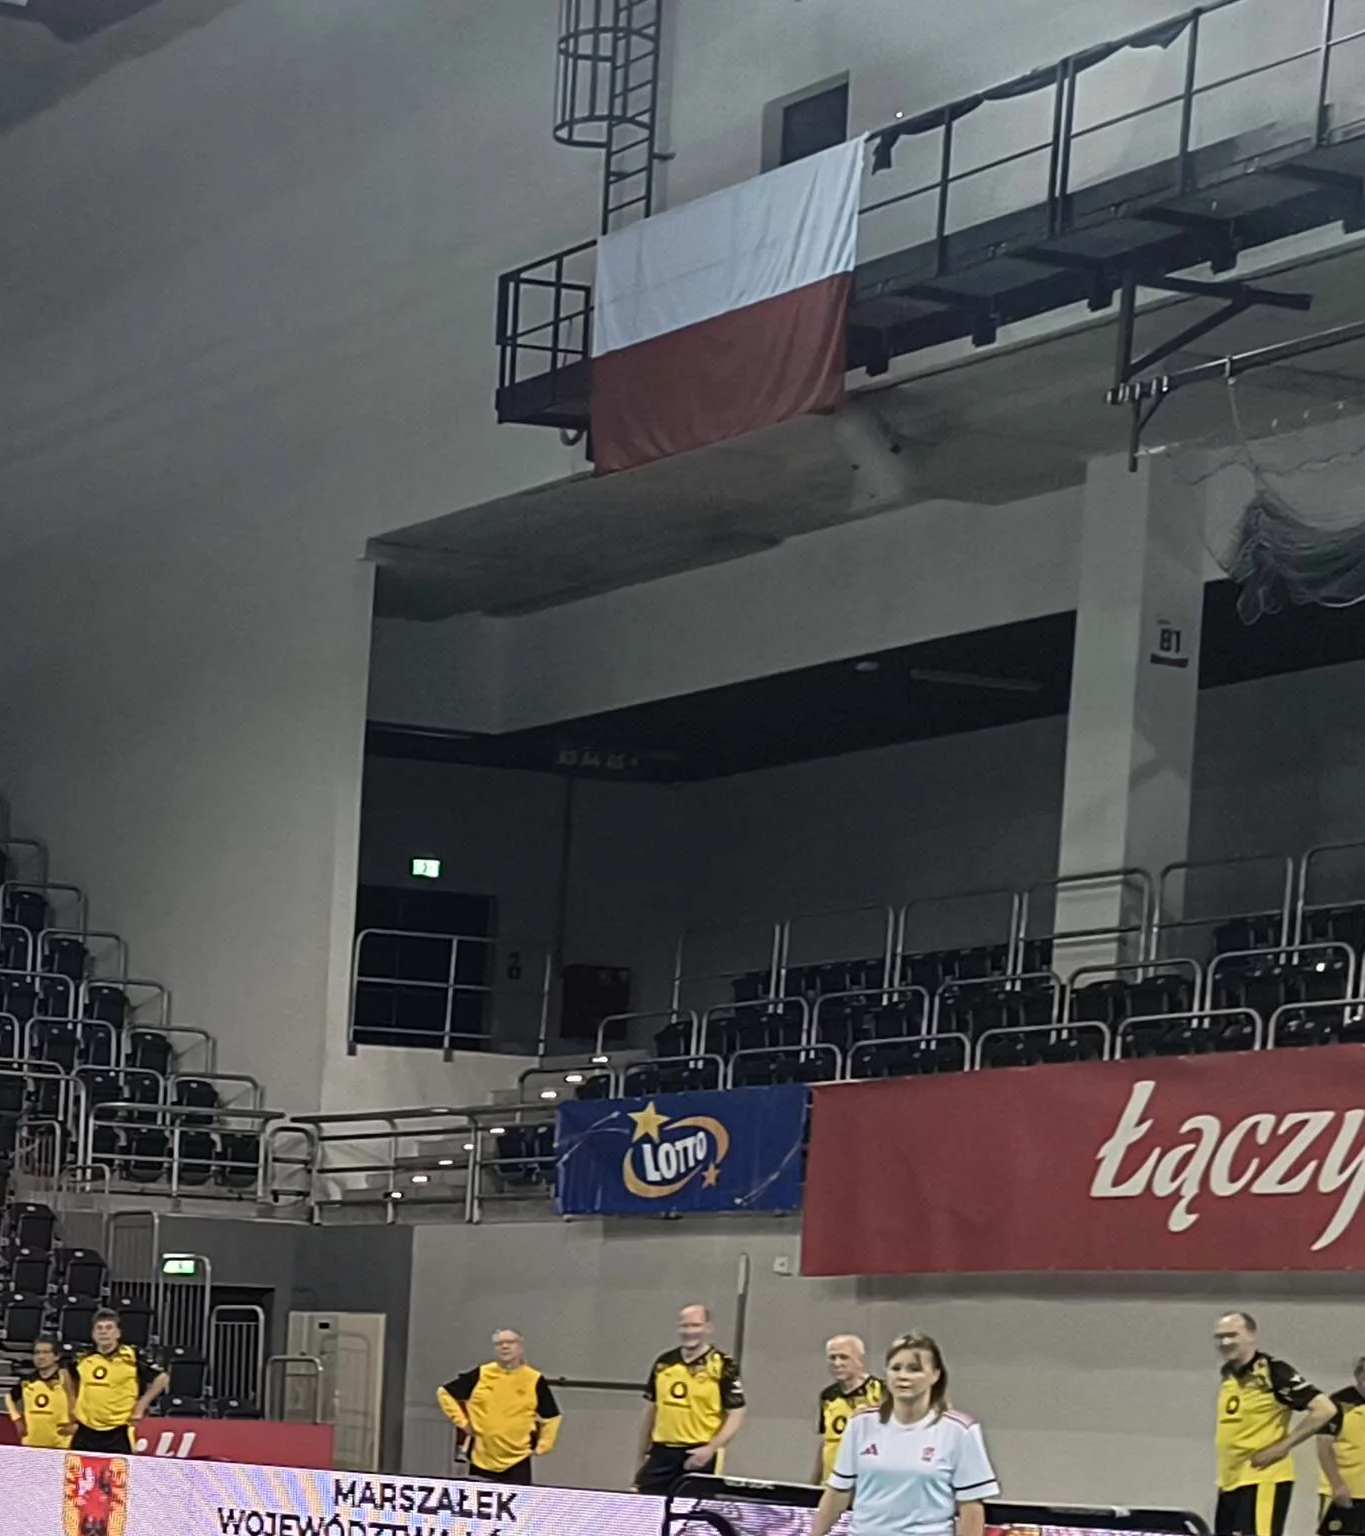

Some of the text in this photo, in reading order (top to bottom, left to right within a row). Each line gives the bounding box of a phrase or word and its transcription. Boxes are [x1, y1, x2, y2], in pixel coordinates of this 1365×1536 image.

[642, 1131, 707, 1182] LOTTO
[1089, 1080, 1365, 1251] Łączy
[334, 1479, 517, 1522] MARSZAŁEK
